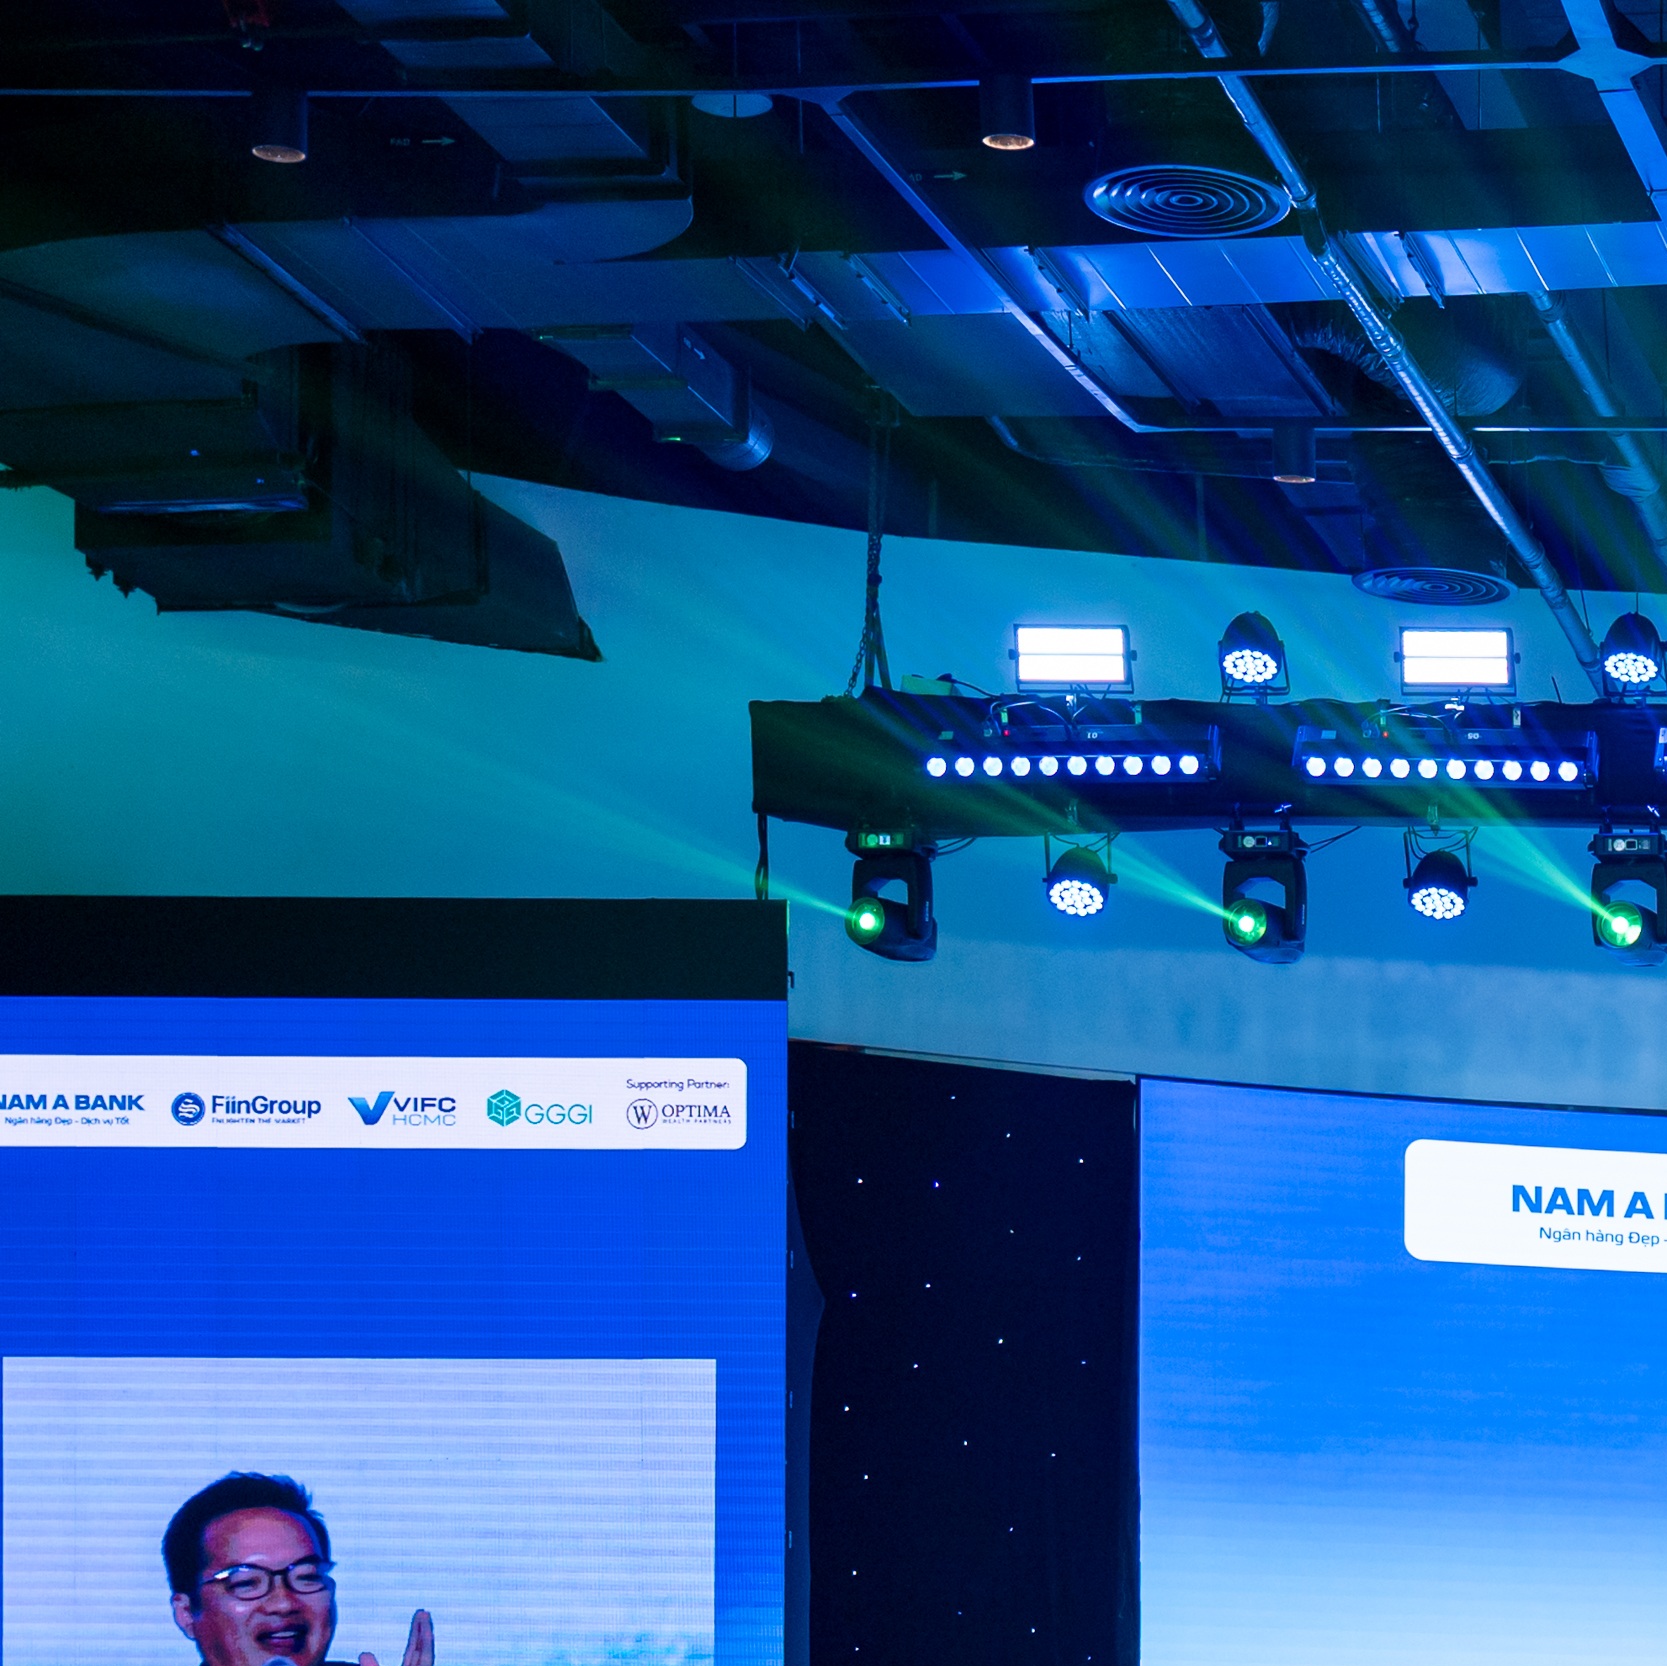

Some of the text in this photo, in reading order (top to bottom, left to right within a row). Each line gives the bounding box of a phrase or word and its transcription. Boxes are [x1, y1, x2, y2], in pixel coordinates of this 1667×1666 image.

[627, 1079, 684, 1091] Supporting
[52, 1095, 69, 1110] A
[75, 1095, 144, 1110] BANK
[212, 1095, 321, 1122] FiinGroup
[394, 1097, 455, 1112] VIFC
[525, 1104, 592, 1124] GGGI
[661, 1103, 731, 1118] OPTIMA
[393, 1114, 456, 1126] HCMC
[1512, 1185, 1614, 1217] NAM
[1624, 1192, 1654, 1219] A
[1539, 1225, 1580, 1247] Ngân
[1583, 1227, 1624, 1248] hàng
[1628, 1230, 1660, 1251] Đẹp
